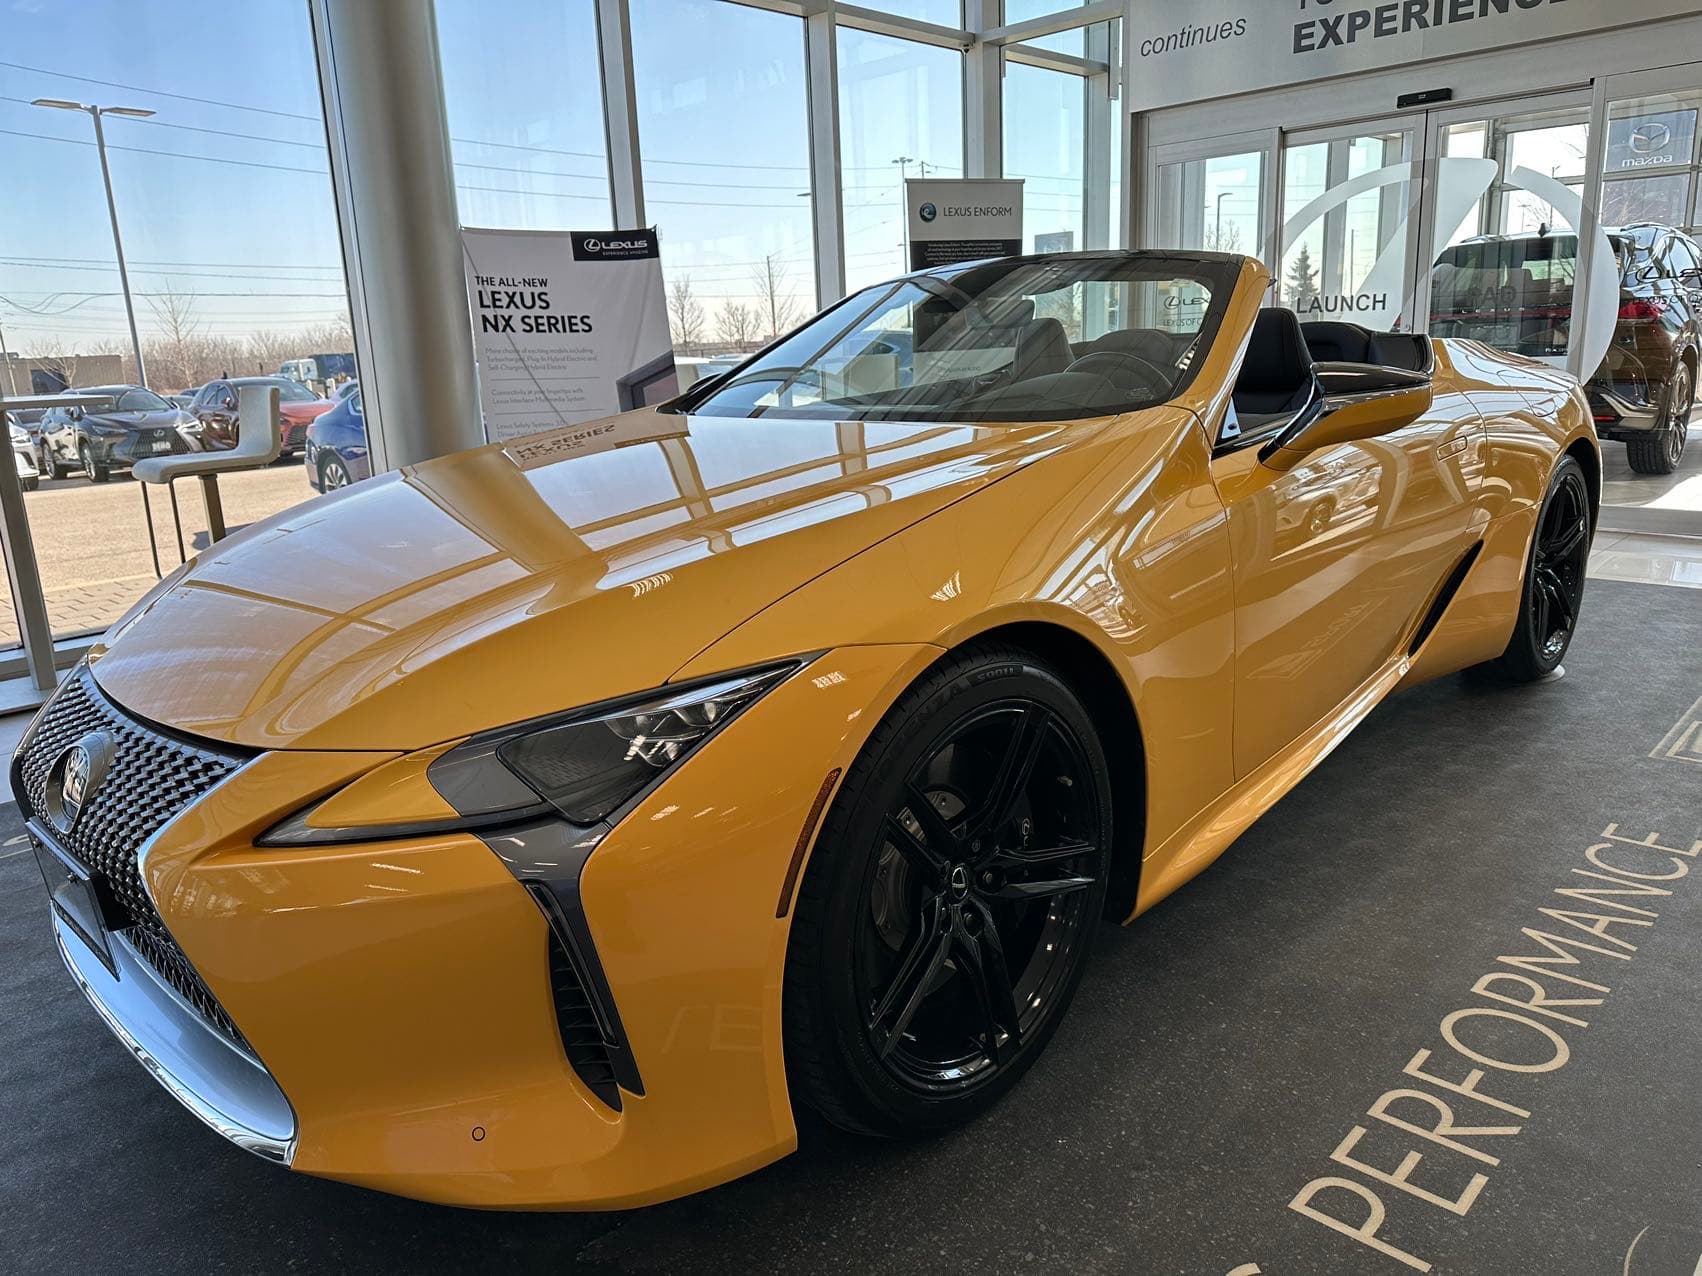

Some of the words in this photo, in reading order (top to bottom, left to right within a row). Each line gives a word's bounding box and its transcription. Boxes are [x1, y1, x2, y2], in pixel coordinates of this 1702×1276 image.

[1140, 18, 1247, 57] continues
[1293, 0, 1568, 54] EXPERIEN
[943, 206, 972, 217] LEXUS
[974, 206, 1012, 217] ENFORM
[601, 240, 648, 249] LEXUS
[475, 276, 496, 286] THE
[498, 277, 548, 287] ALL-NEW
[478, 290, 550, 310] LEXUS
[1297, 293, 1387, 313] LAUNCH
[481, 314, 516, 333] NX
[522, 315, 593, 333] SERIES
[1287, 823, 1702, 1272] PERFORMANCE
